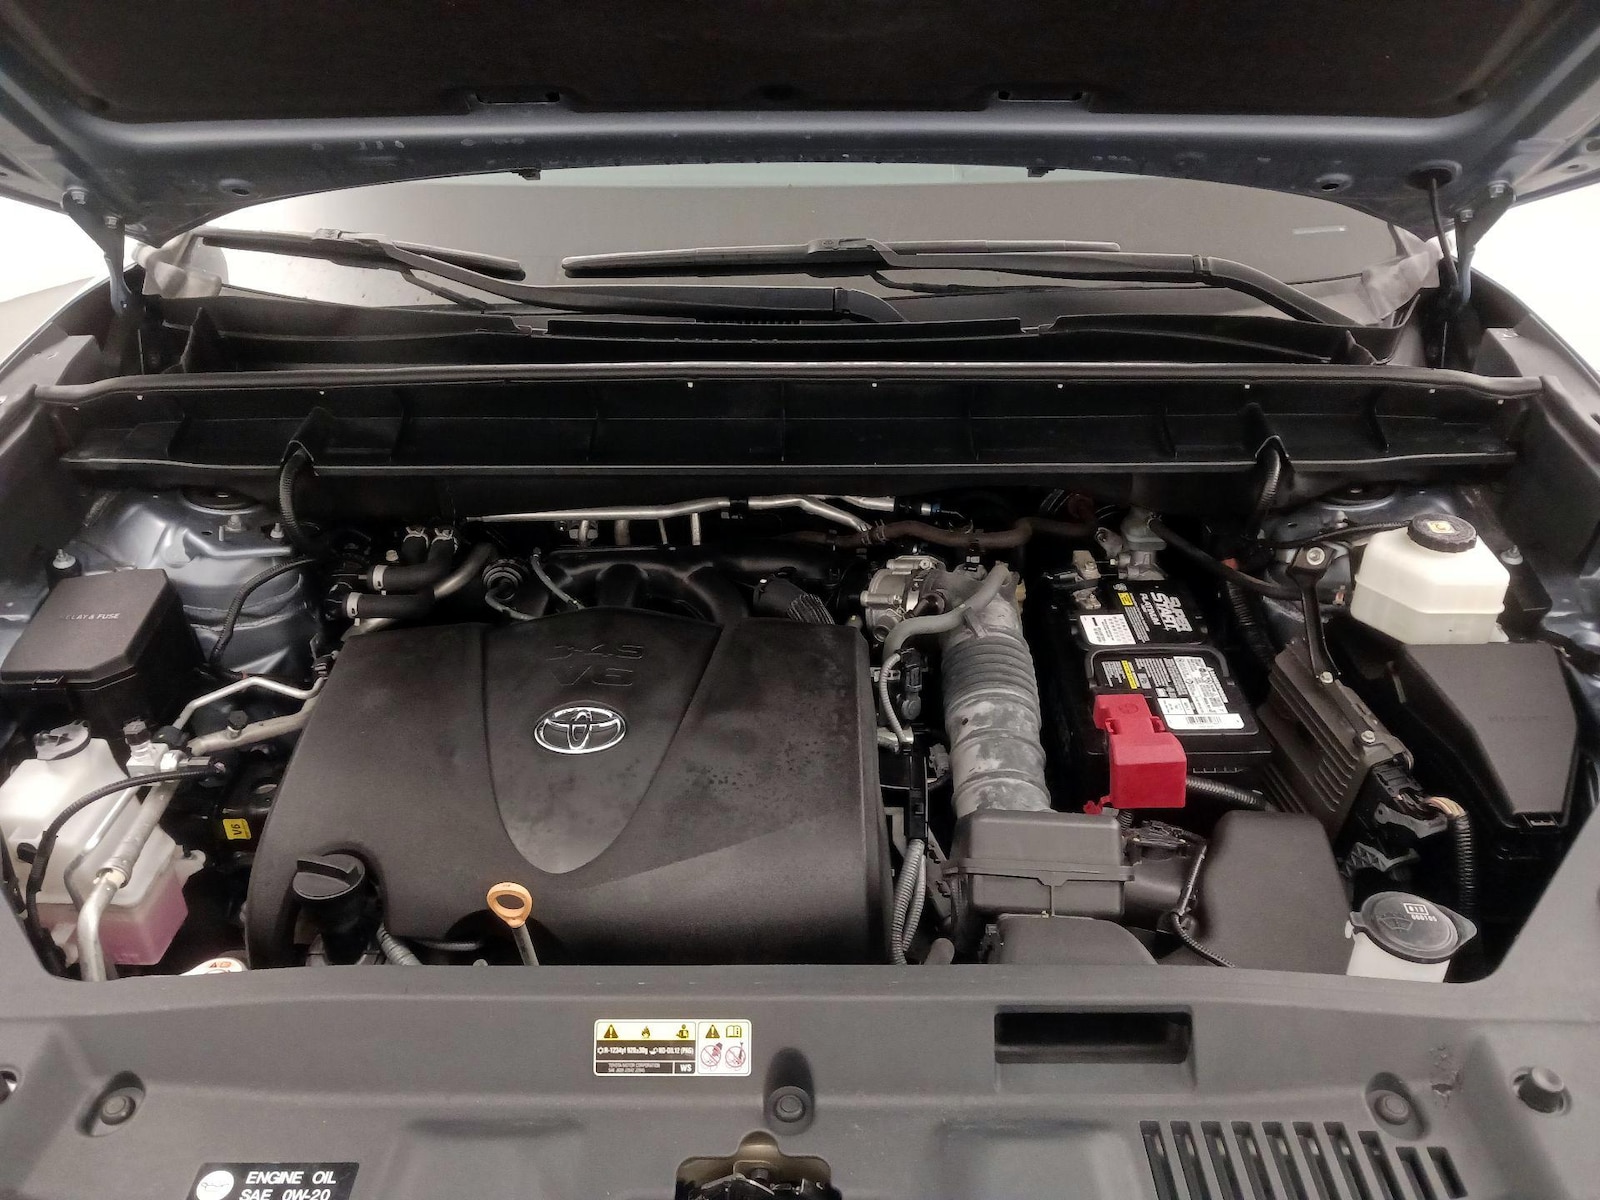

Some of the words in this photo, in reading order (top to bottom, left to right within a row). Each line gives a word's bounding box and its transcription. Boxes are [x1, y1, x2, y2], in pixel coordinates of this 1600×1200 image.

[96, 612, 121, 620] FUSE
[1139, 592, 1162, 626] PLATINUM
[1150, 591, 1180, 632] START
[1169, 596, 1194, 633] SUPER
[680, 1064, 692, 1072] WS
[245, 1171, 304, 1185] ENGINE
[312, 1171, 337, 1185] OIL
[239, 1188, 273, 1200] SAE
[282, 1188, 331, 1200] 0W-20
